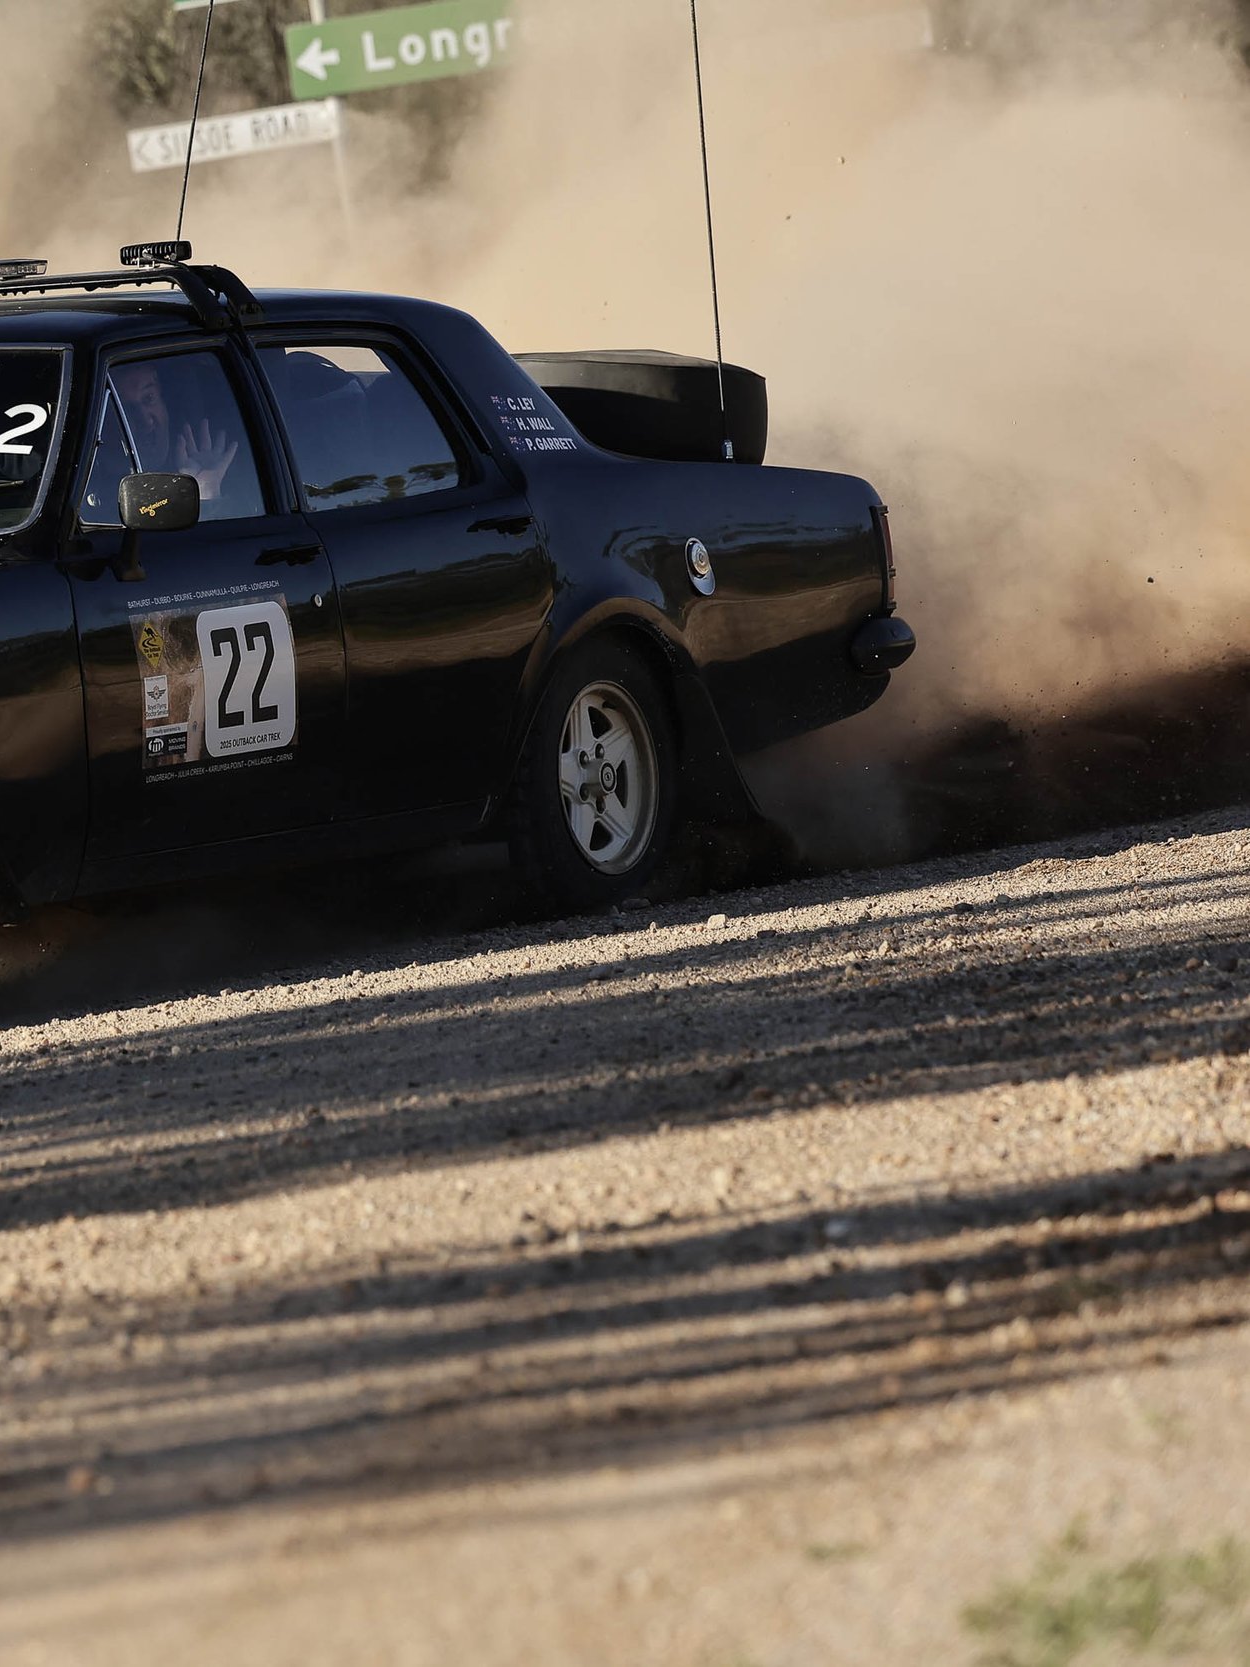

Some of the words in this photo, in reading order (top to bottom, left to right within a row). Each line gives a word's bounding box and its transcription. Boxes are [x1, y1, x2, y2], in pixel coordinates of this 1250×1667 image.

[251, 110, 311, 147] ROAD
[517, 397, 536, 411] LEY
[526, 417, 555, 431] WALL
[534, 437, 577, 451] GARRETT
[127, 599, 151, 609] BATHURST
[153, 595, 171, 605] DUBBO
[173, 592, 194, 602] BOURKE
[196, 587, 228, 599] CUNNAMULLA
[230, 584, 249, 595] QUILPIE
[251, 580, 280, 591] LONGREACH
[210, 621, 279, 729] 22
[219, 740, 232, 749] 2025
[232, 736, 257, 747] OUTBACK
[256, 733, 268, 743] CAR
[268, 732, 281, 742] TREK
